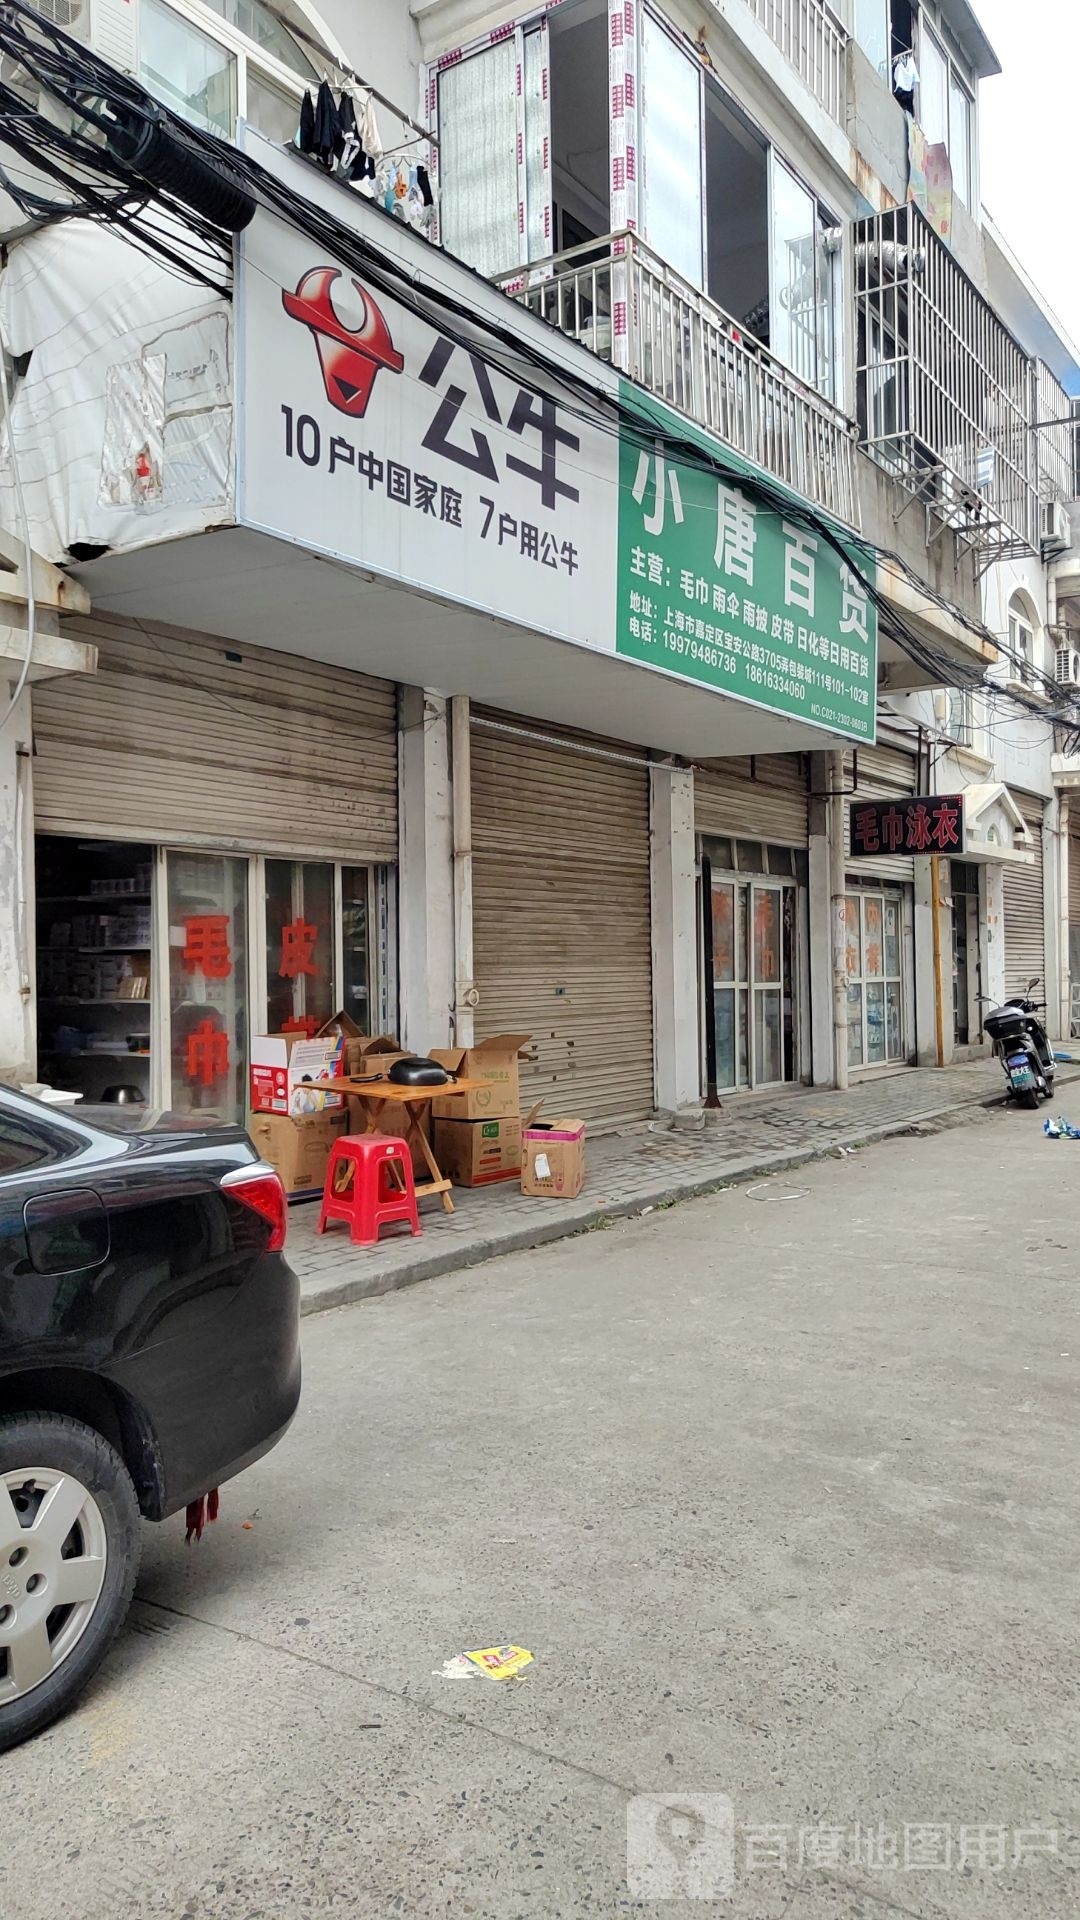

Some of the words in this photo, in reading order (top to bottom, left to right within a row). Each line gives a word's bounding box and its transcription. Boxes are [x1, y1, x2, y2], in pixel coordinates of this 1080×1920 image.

[280, 403, 463, 529] 10户中国家庭
[479, 495, 579, 577] 7户用公牛
[418, 335, 580, 510] 公牛
[631, 439, 870, 644] 小唐百货
[712, 584, 740, 620] 雨伞
[743, 599, 768, 636] 雨披
[771, 613, 795, 646] 皮带
[796, 626, 869, 679] 日化等日用百货
[745, 664, 806, 701] 18616334060
[855, 803, 959, 852] 毛巾泳衣
[182, 914, 233, 1086] 毛巾
